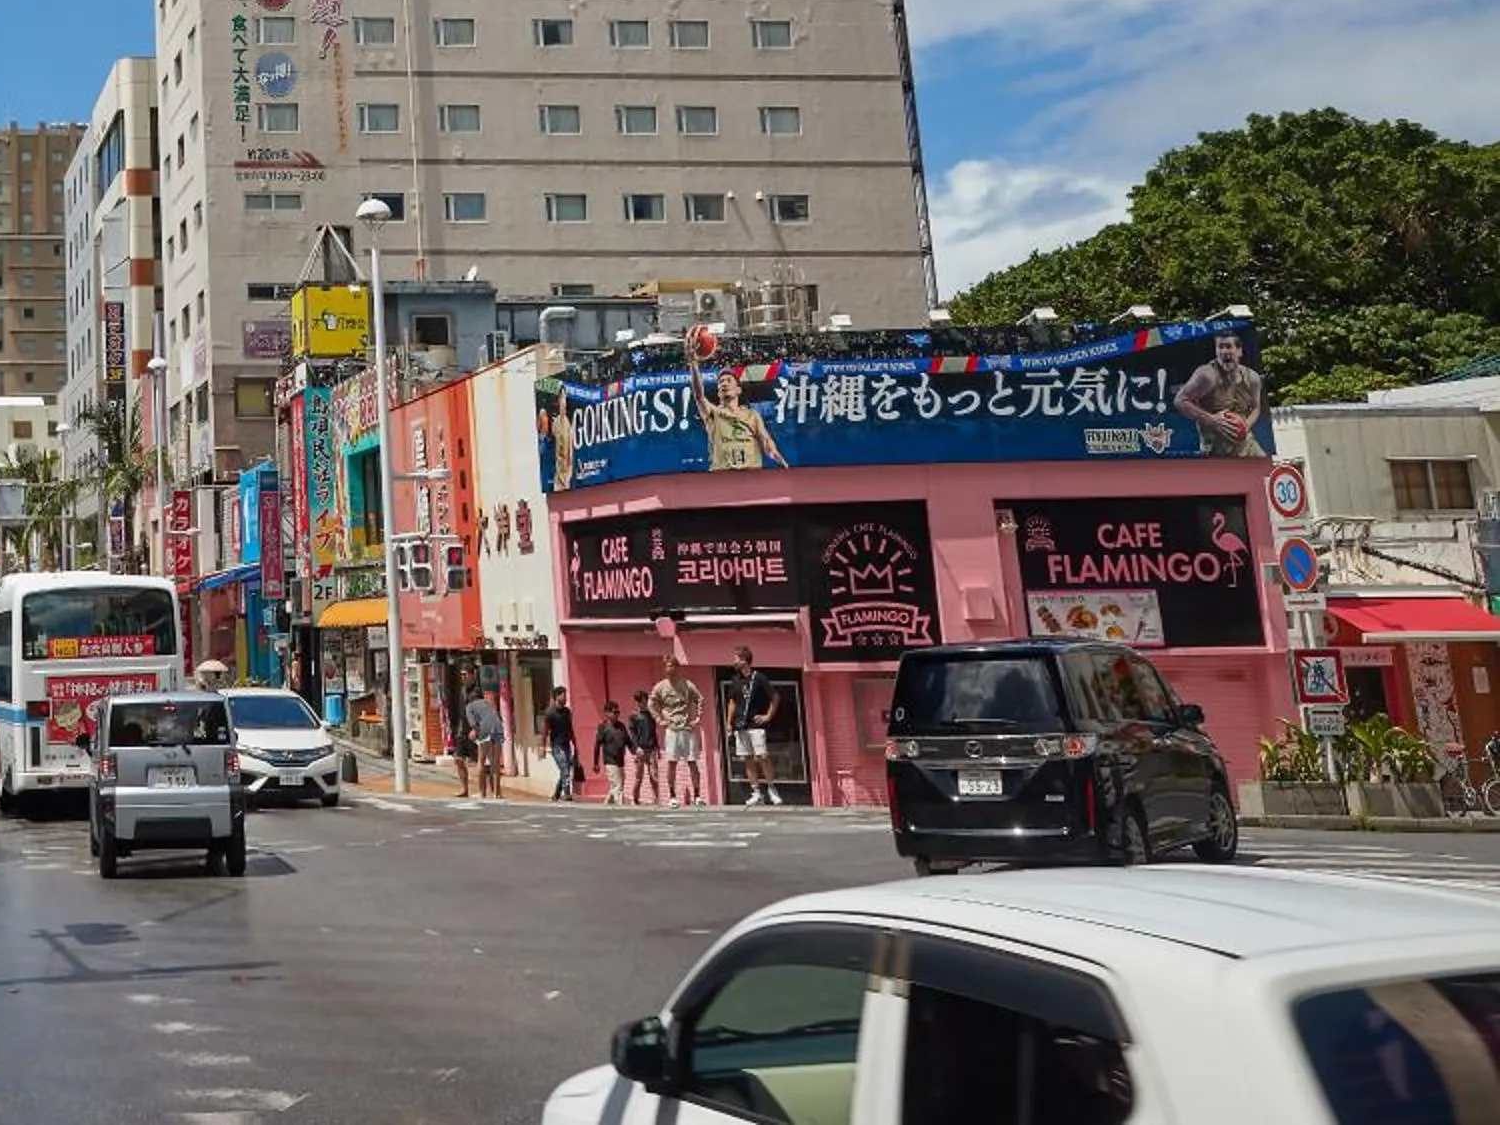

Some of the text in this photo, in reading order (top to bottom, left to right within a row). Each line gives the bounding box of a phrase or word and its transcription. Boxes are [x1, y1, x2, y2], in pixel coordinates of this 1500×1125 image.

[773, 368, 1168, 424] 沖縄をもっと元気に!
[1276, 479, 1298, 505] 30
[175, 497, 191, 568] カラオケ
[1097, 523, 1164, 549] CAFE
[601, 535, 629, 564] CAFE
[677, 557, 788, 586] 코리아마트
[1047, 552, 1220, 585] FLAMINGO
[313, 584, 334, 600] 2F
[584, 567, 654, 601] FLAMINGO
[840, 611, 910, 627] FLAMINGO
